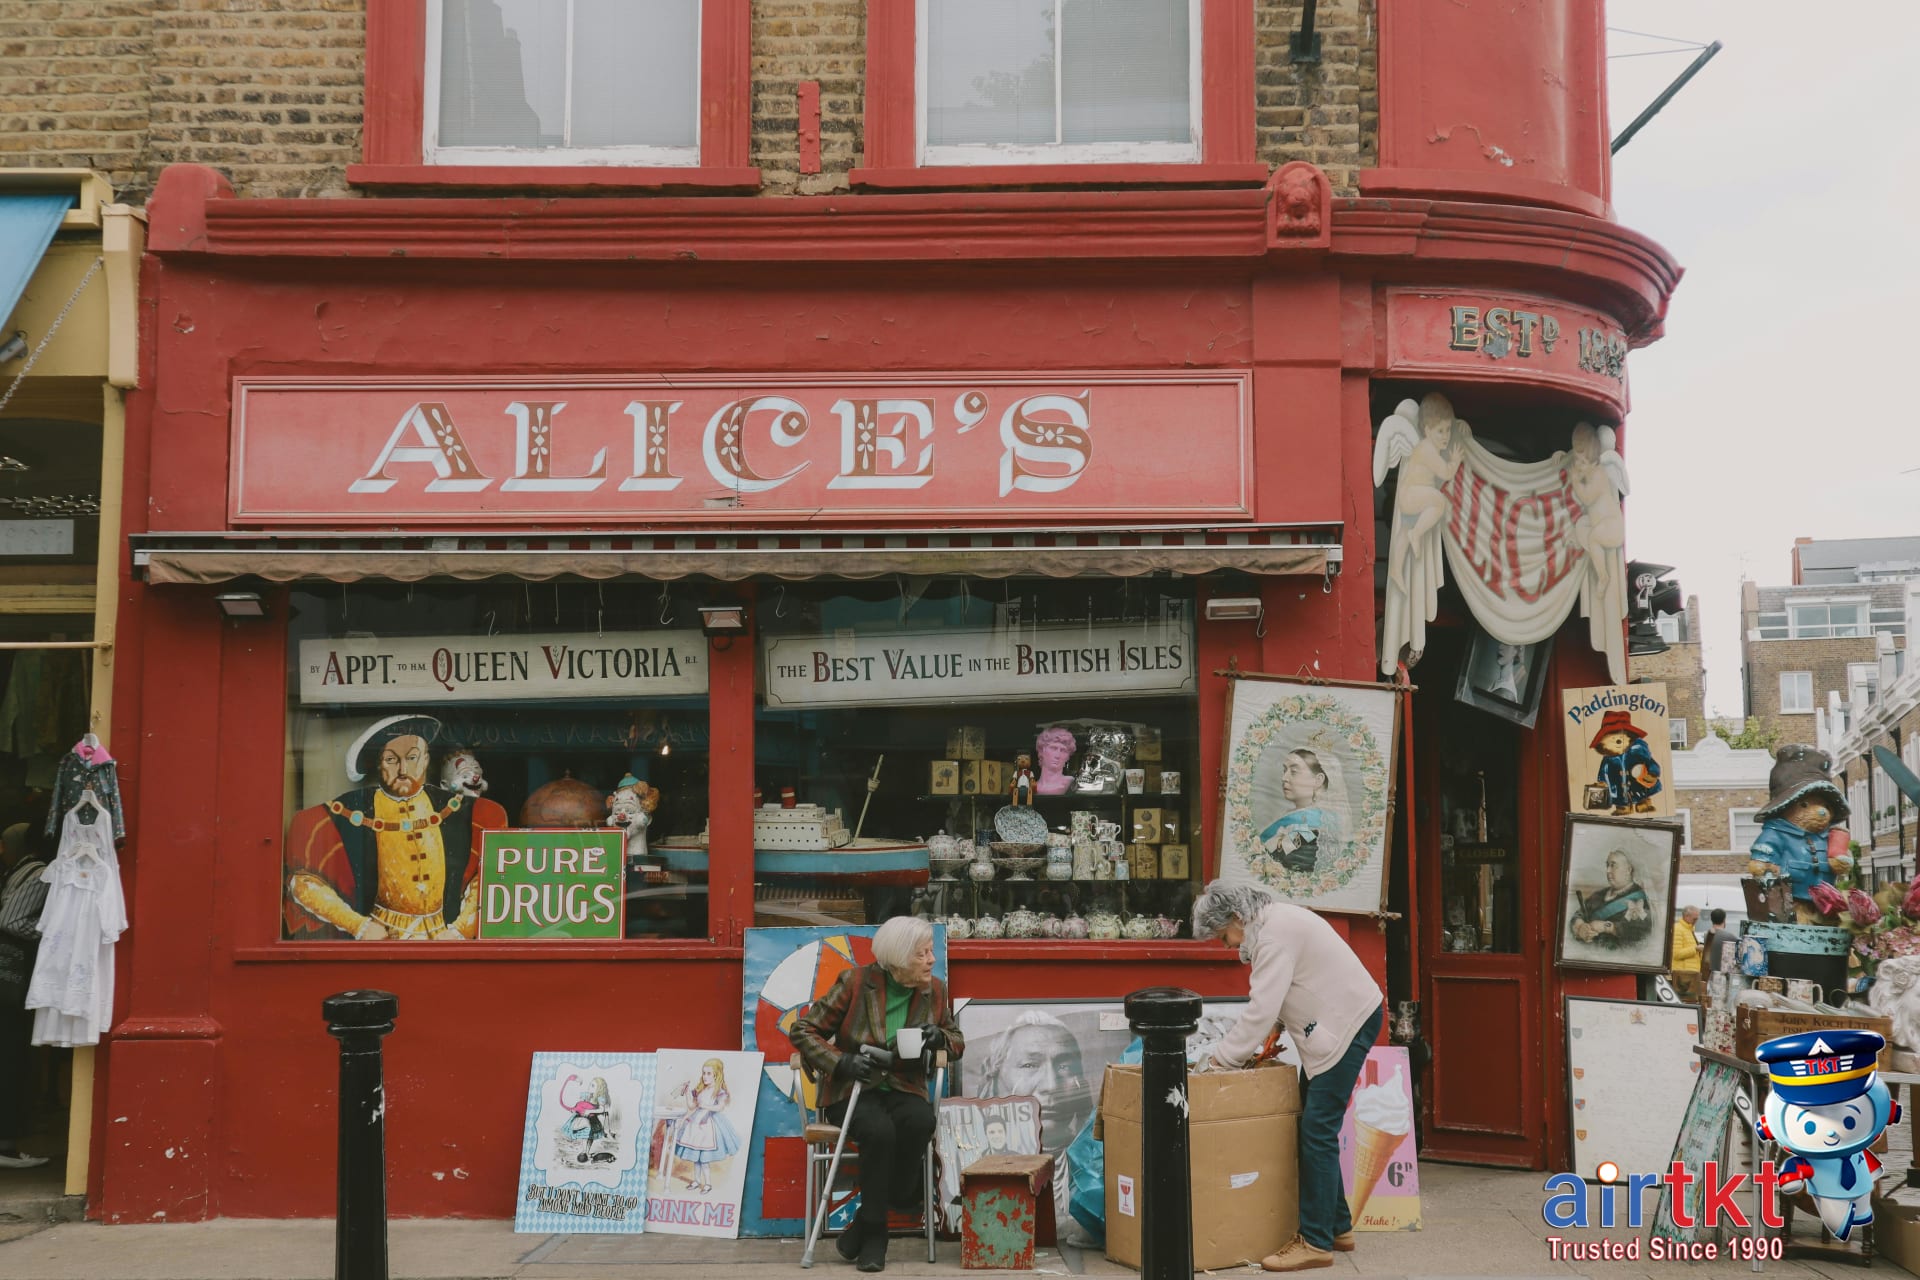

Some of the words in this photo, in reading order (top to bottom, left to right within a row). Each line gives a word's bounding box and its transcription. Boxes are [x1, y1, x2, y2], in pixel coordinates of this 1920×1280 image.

[348, 388, 1094, 497] ALICE'S
[310, 665, 320, 674] BY
[322, 651, 396, 685] APPT.
[397, 663, 407, 671] TO
[432, 647, 528, 692] QUEEN
[540, 645, 681, 680] VICTORIA
[777, 665, 807, 678] THE
[812, 651, 875, 682] BEST
[882, 649, 963, 680] VALUE
[968, 658, 982, 671] IN
[985, 658, 1010, 671] THE
[1016, 644, 1111, 675] BRITISH
[1118, 640, 1182, 672] ISLES
[1568, 689, 1665, 725] Paddington
[497, 846, 608, 875] PURE
[486, 883, 616, 928] DRUGS
[1777, 1014, 1807, 1026] JOHN
[645, 1198, 701, 1226] RINK
[702, 1201, 735, 1228] ME
